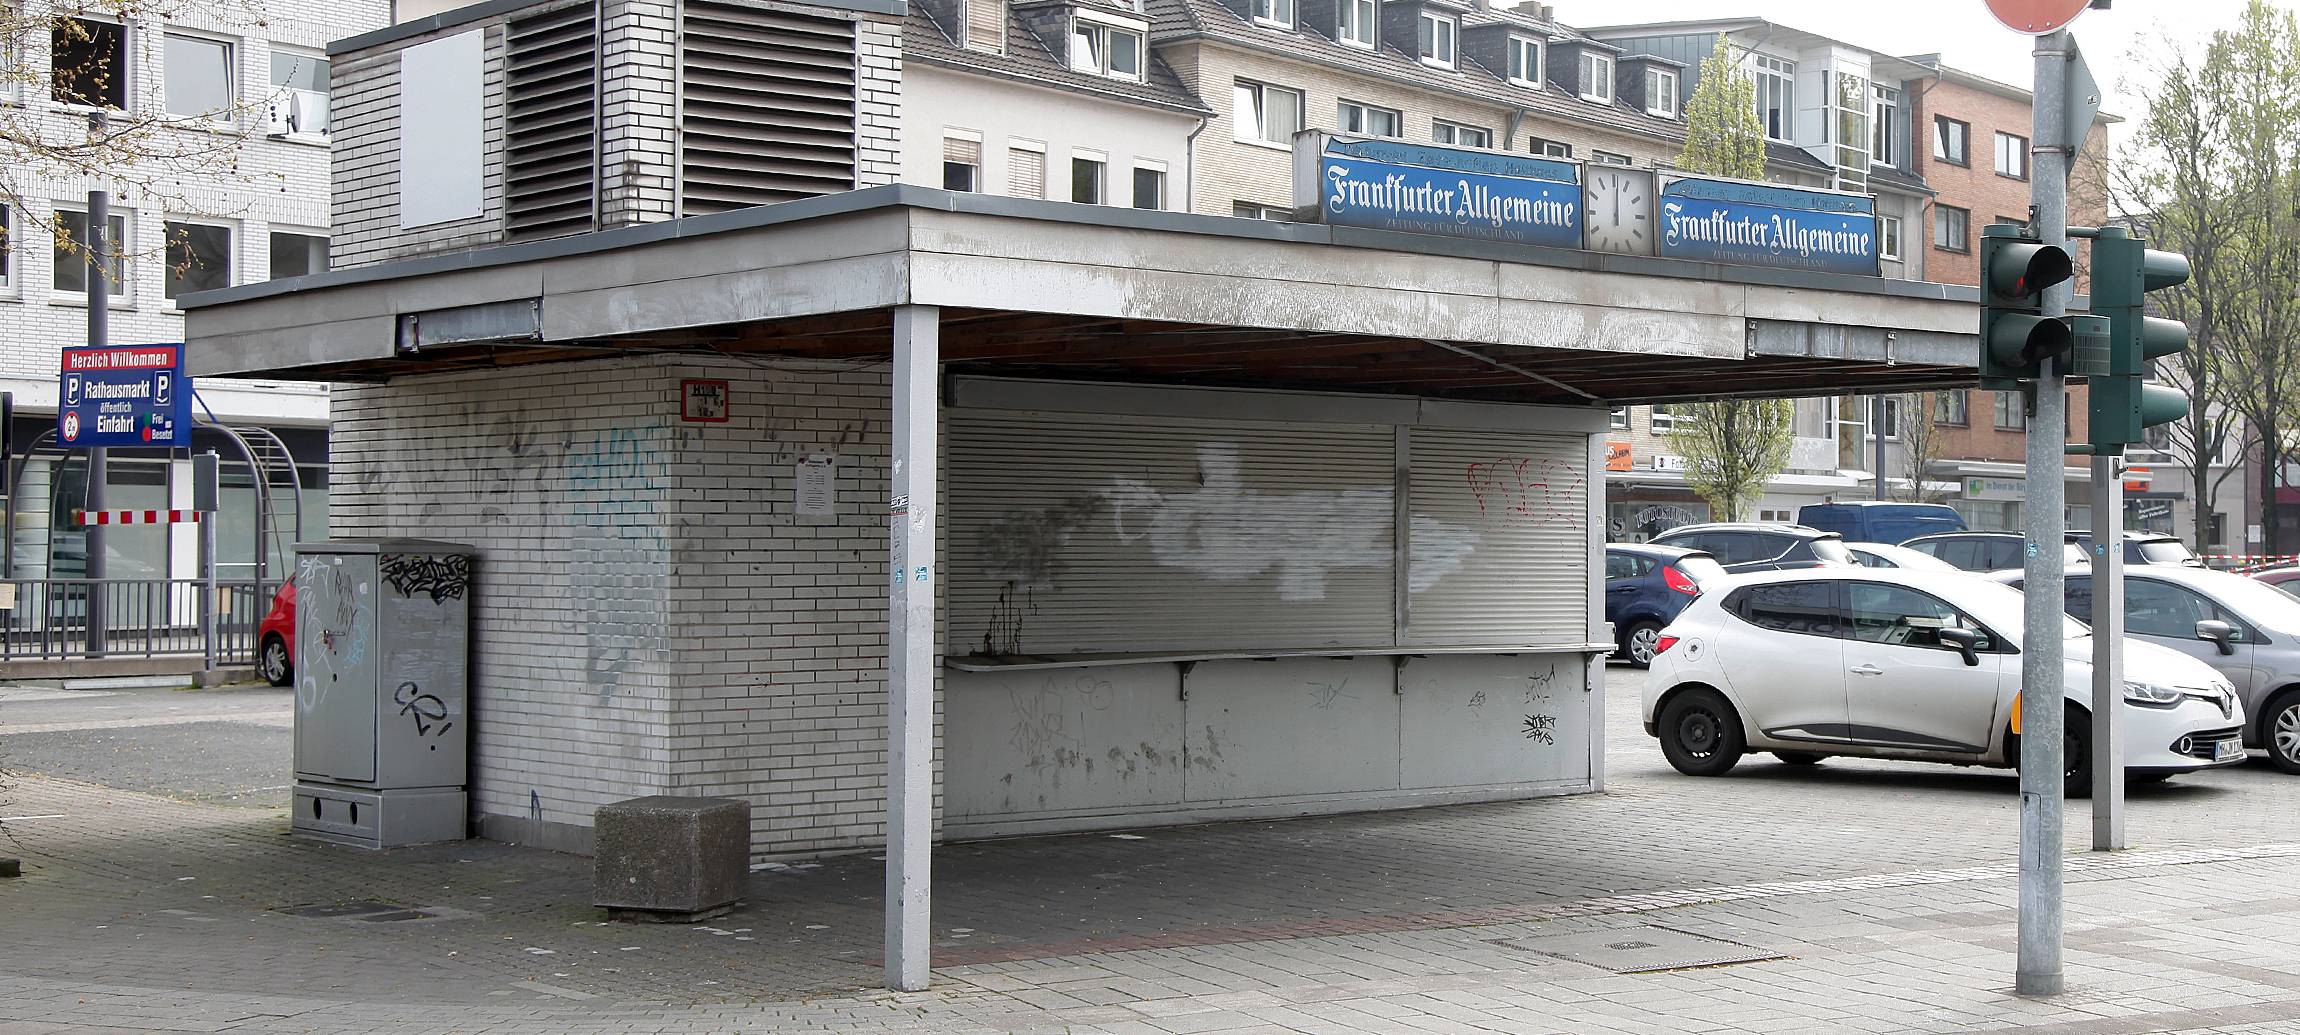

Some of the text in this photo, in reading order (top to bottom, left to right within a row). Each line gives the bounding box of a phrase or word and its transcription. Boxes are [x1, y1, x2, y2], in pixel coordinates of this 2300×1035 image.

[1327, 165, 1454, 216] Frankfurter
[1455, 179, 1574, 228] Allgemeine
[1664, 202, 1869, 257] Frankfurter Allgemeine
[71, 351, 167, 368] Herzlich Willkommen
[85, 380, 150, 399] Rathausmarkt
[100, 401, 131, 414] öffentlich
[97, 415, 134, 433] Einfahrt
[152, 413, 164, 424] Frei
